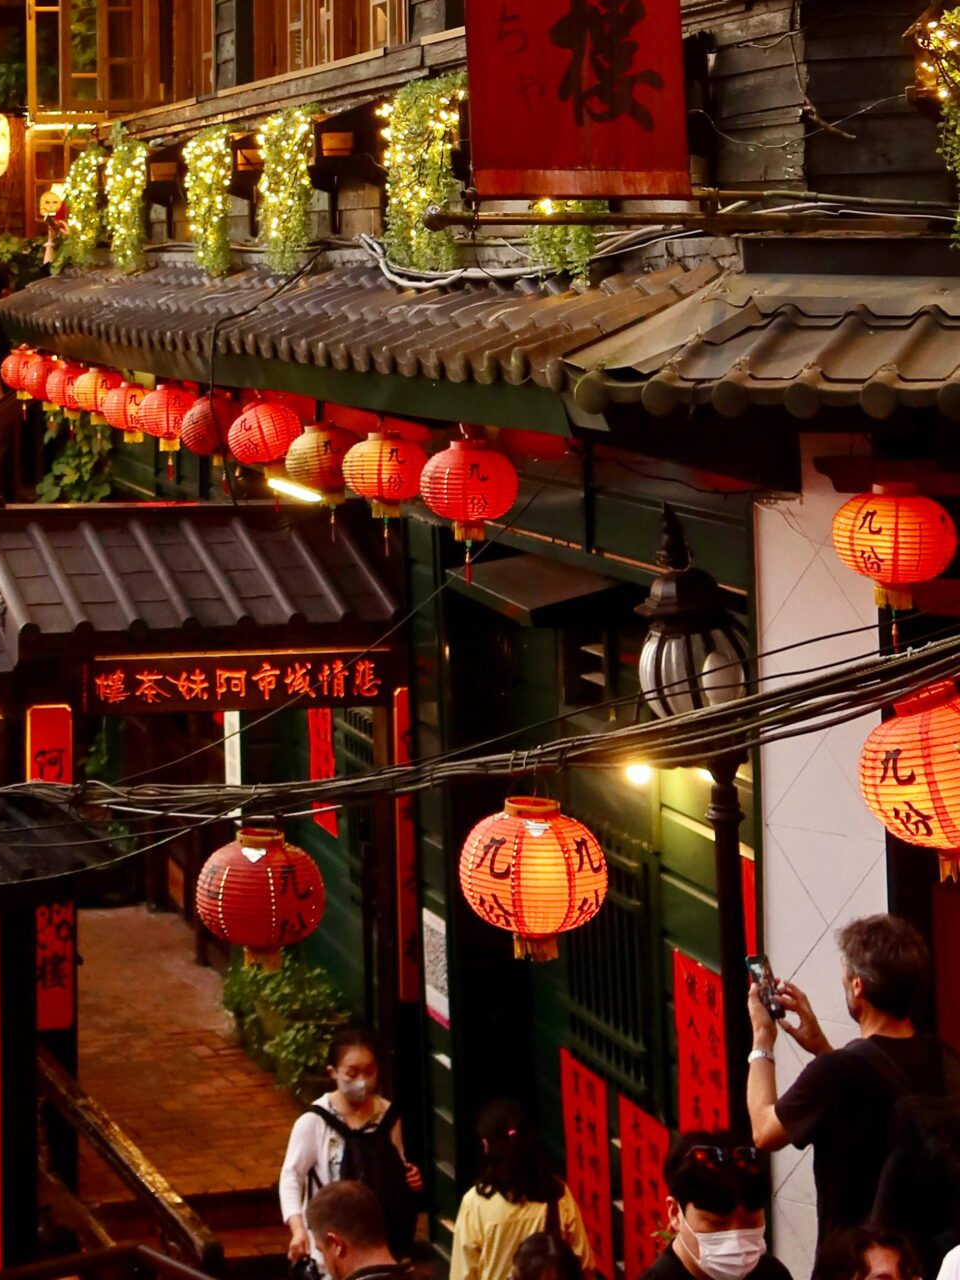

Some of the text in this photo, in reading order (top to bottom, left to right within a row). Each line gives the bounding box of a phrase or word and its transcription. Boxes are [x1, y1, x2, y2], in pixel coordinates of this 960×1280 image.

[387, 447, 407, 492] 九份
[467, 463, 490, 516] 九份
[858, 509, 886, 573] 九份
[880, 748, 935, 838] 九份
[475, 836, 515, 929] 九份
